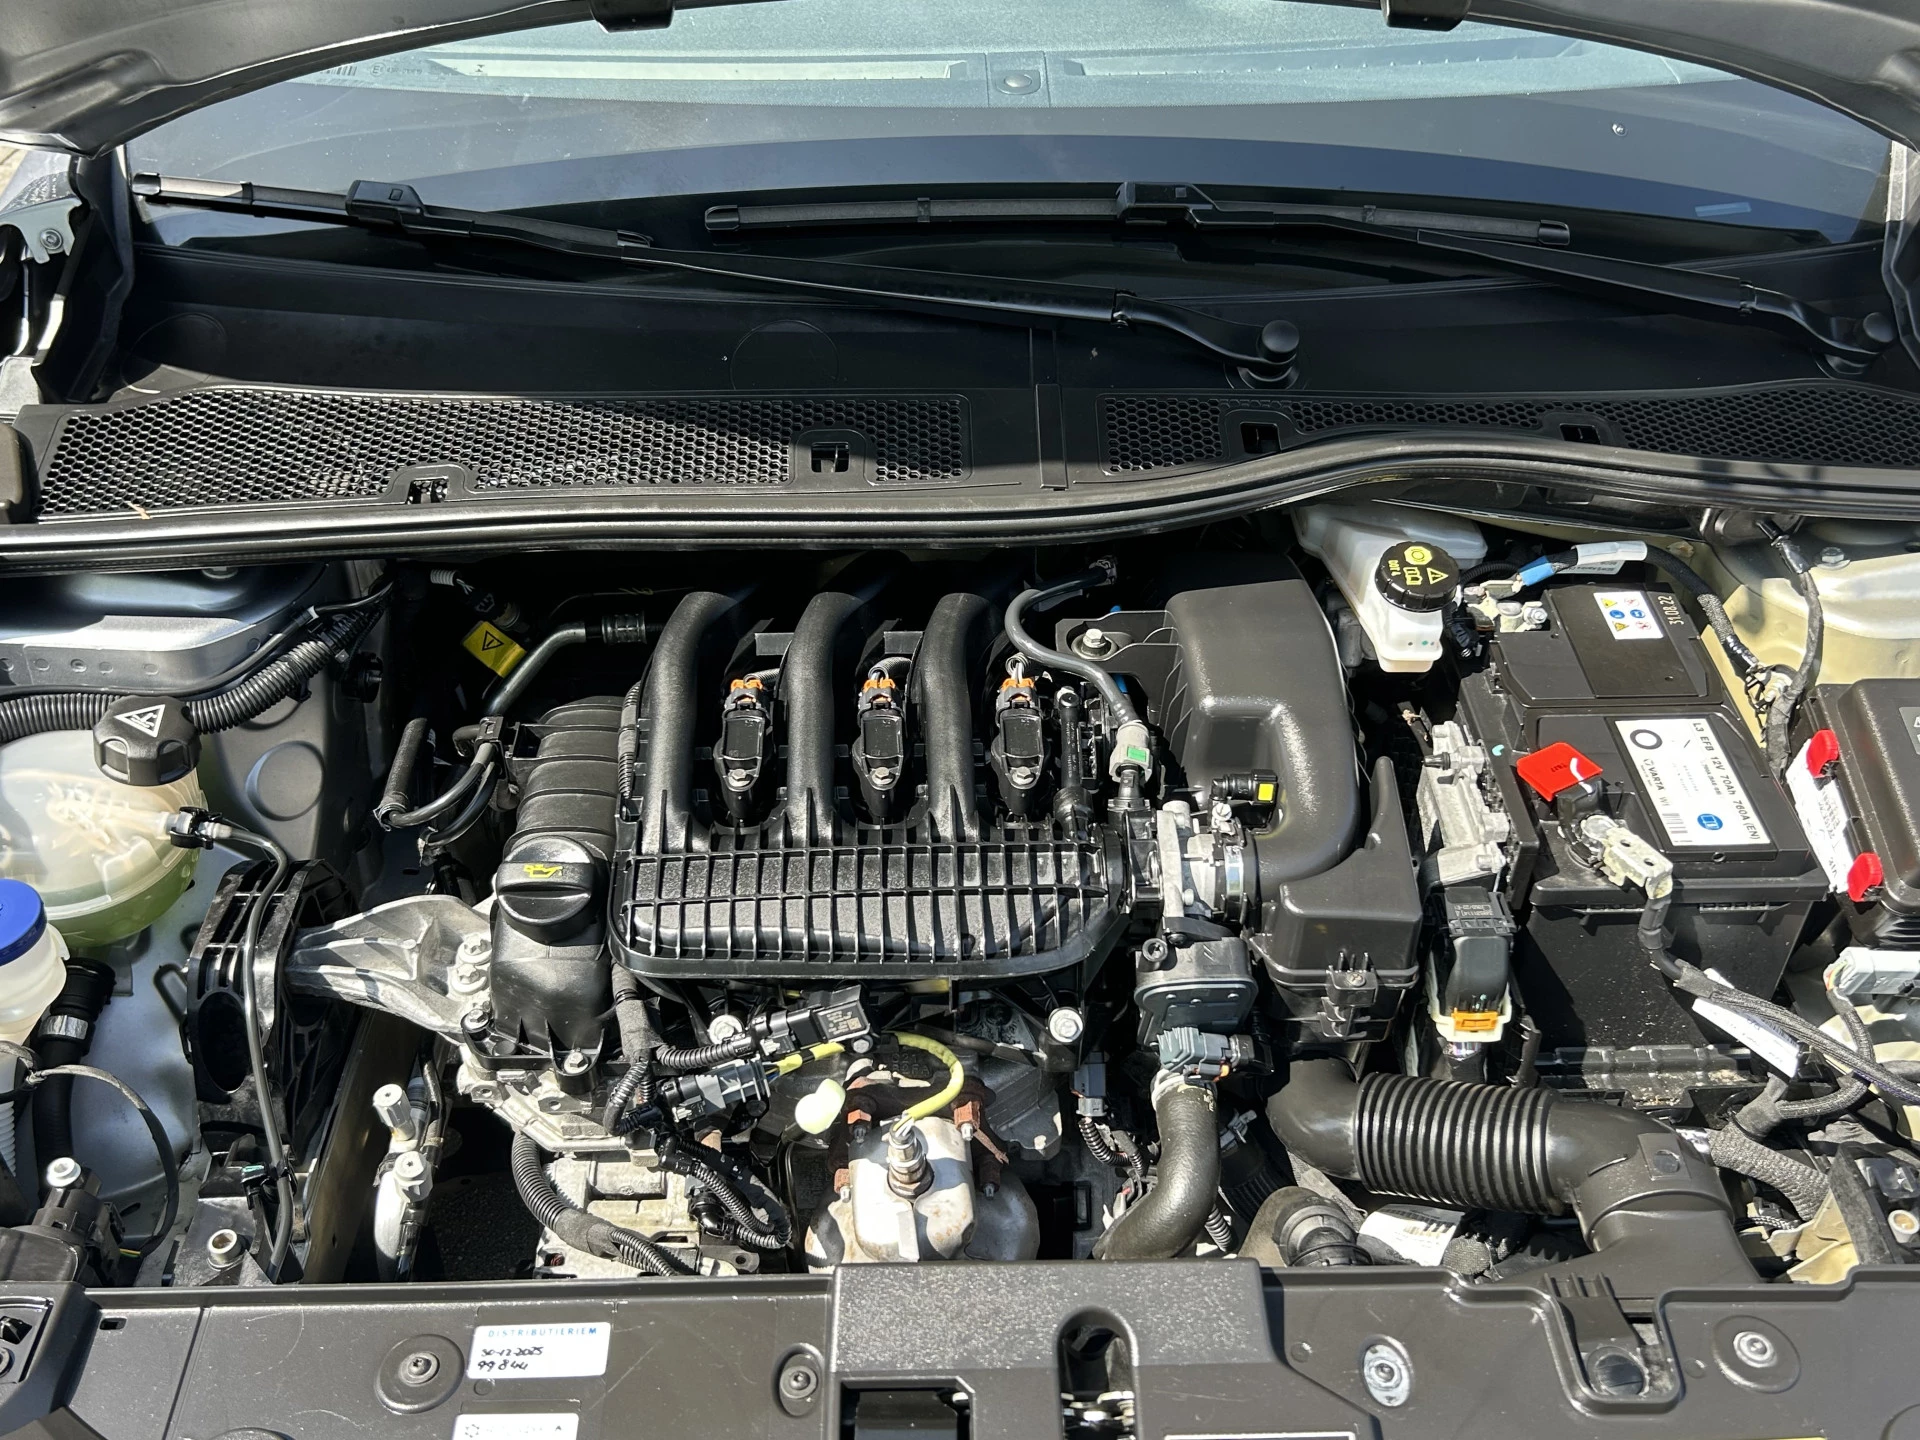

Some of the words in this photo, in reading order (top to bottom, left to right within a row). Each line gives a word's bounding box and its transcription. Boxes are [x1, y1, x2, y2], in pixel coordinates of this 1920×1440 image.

[1648, 766, 1665, 791] VARTA
[1710, 756, 1726, 772] 12V
[1720, 774, 1736, 795] 70Ah
[1743, 822, 1761, 840] (EN)
